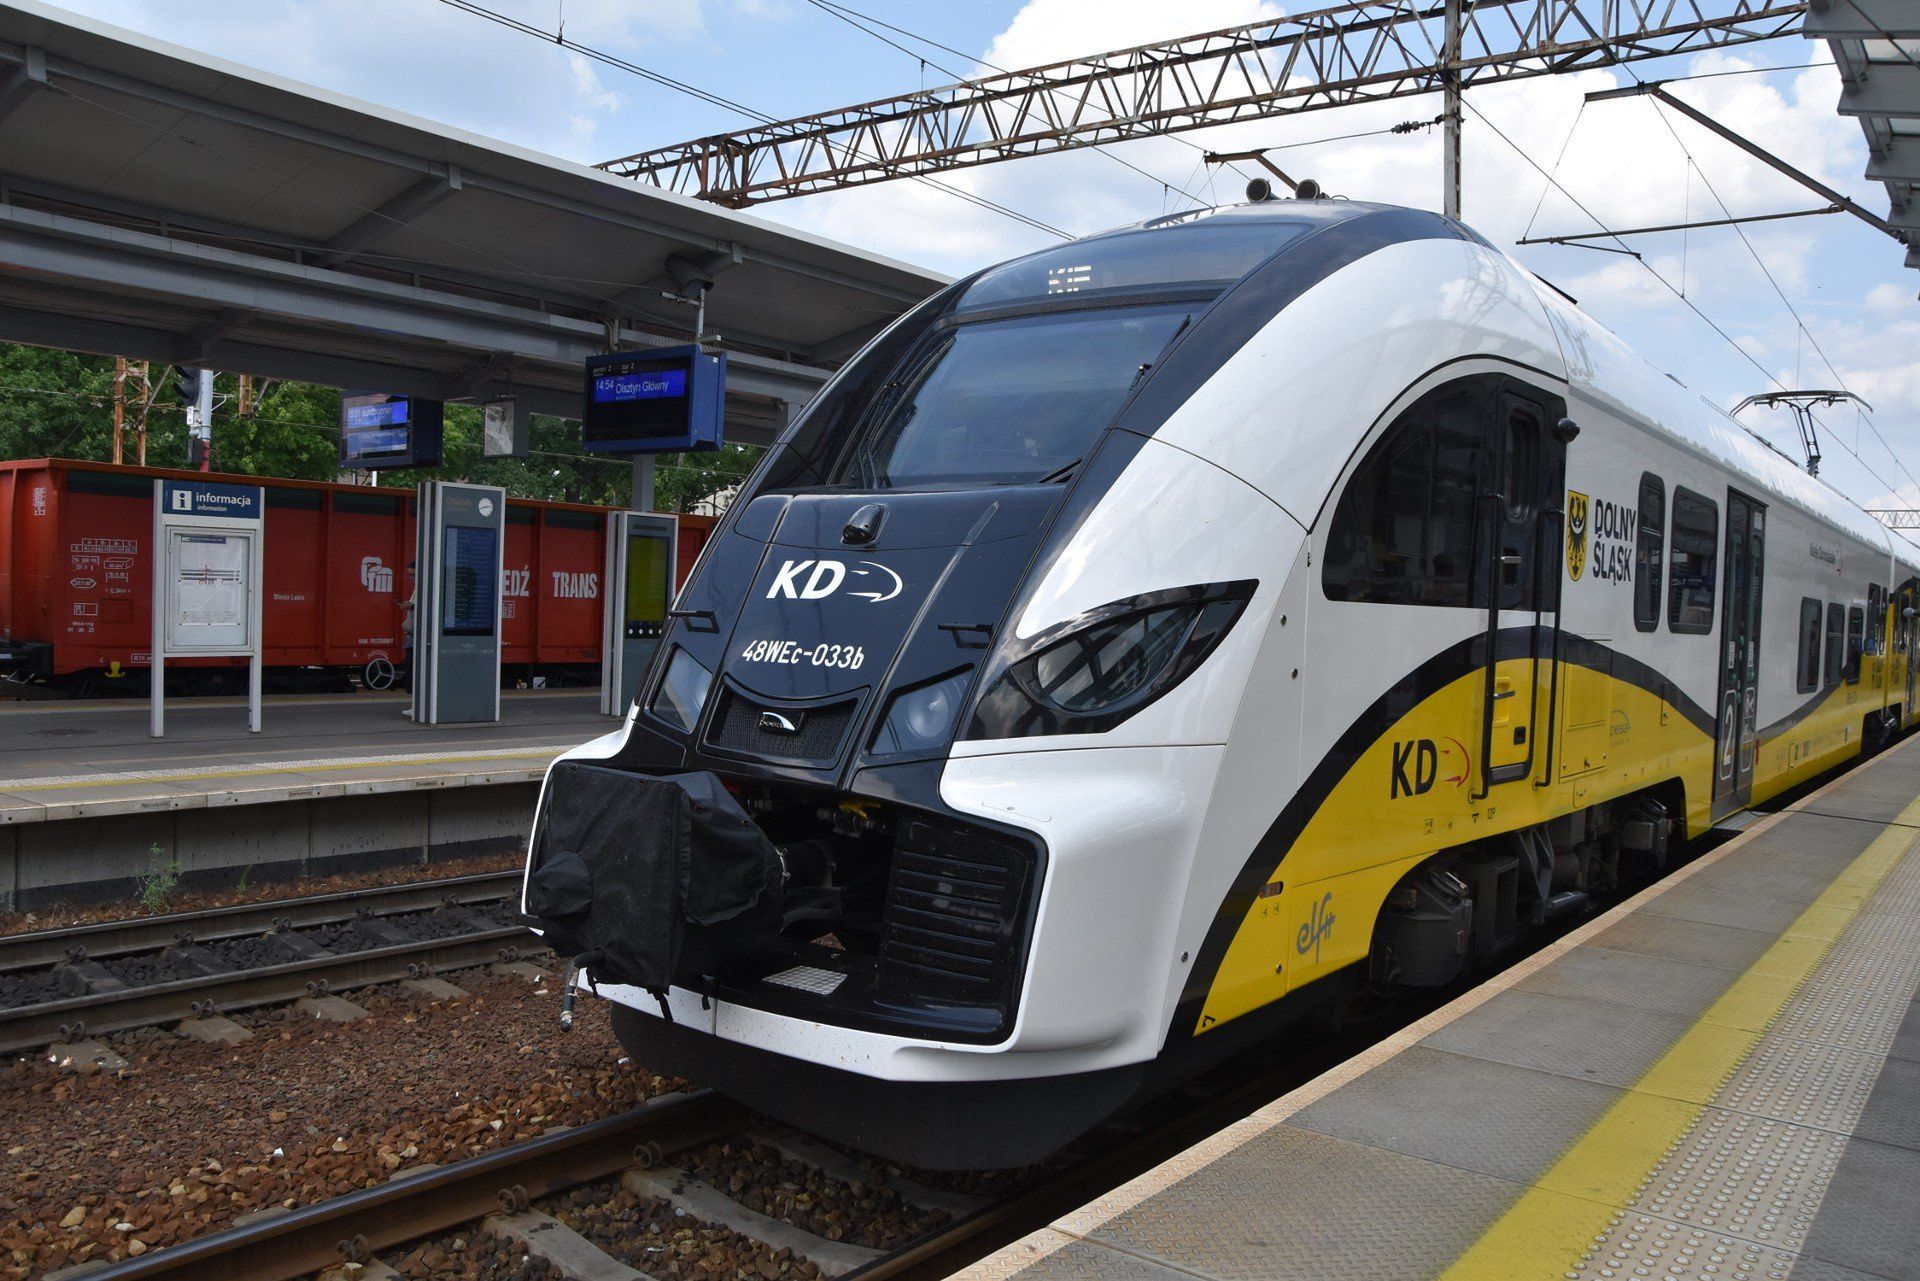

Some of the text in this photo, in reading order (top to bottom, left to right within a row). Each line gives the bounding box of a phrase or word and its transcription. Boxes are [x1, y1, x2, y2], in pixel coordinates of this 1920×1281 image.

[596, 380, 614, 391] 14:54
[616, 381, 669, 394] Olsztyn Główny
[196, 492, 251, 506] informacja
[1594, 499, 1636, 542] DOLNY
[1592, 534, 1632, 586] ŚLĄSK
[502, 566, 598, 598] EDŹ TRANS
[766, 560, 846, 600] KD
[742, 640, 864, 670] 48WEc-033b
[1722, 704, 1732, 766] 2
[1390, 739, 1438, 800] KD
